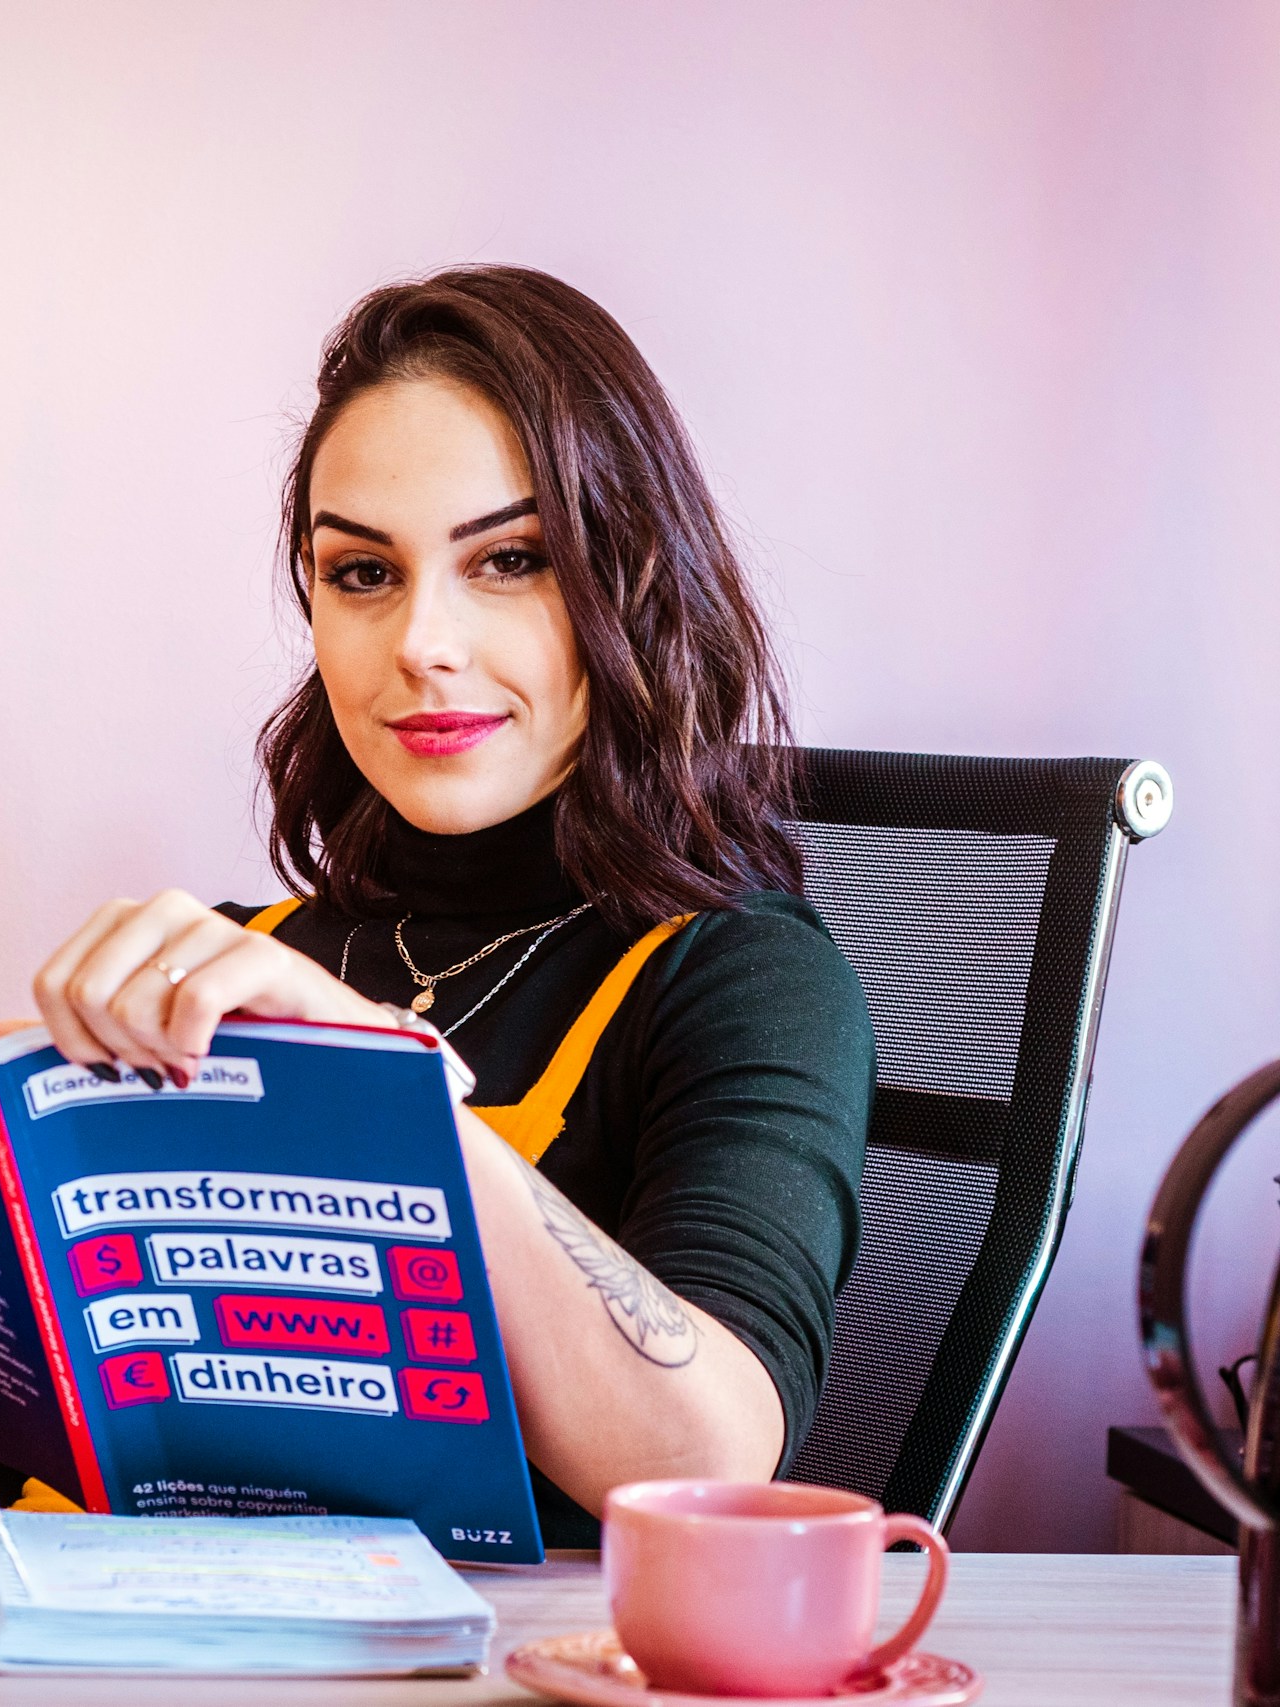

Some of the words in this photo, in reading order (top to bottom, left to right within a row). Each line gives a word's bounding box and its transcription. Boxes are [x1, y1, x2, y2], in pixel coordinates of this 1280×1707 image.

[72, 1177, 436, 1226] transformando
[96, 1243, 122, 1276] $
[166, 1238, 371, 1279] palavras
[407, 1256, 449, 1290] @
[109, 1305, 183, 1330] em
[233, 1309, 376, 1341] www.
[427, 1320, 457, 1349] #
[189, 1359, 387, 1402] dinheiro
[132, 1482, 154, 1495] 42
[157, 1479, 205, 1494] lições
[208, 1484, 238, 1495] que
[240, 1483, 308, 1500] ninguém
[136, 1494, 187, 1509] ensina
[190, 1495, 233, 1509] sobre
[236, 1500, 328, 1517] copywriting
